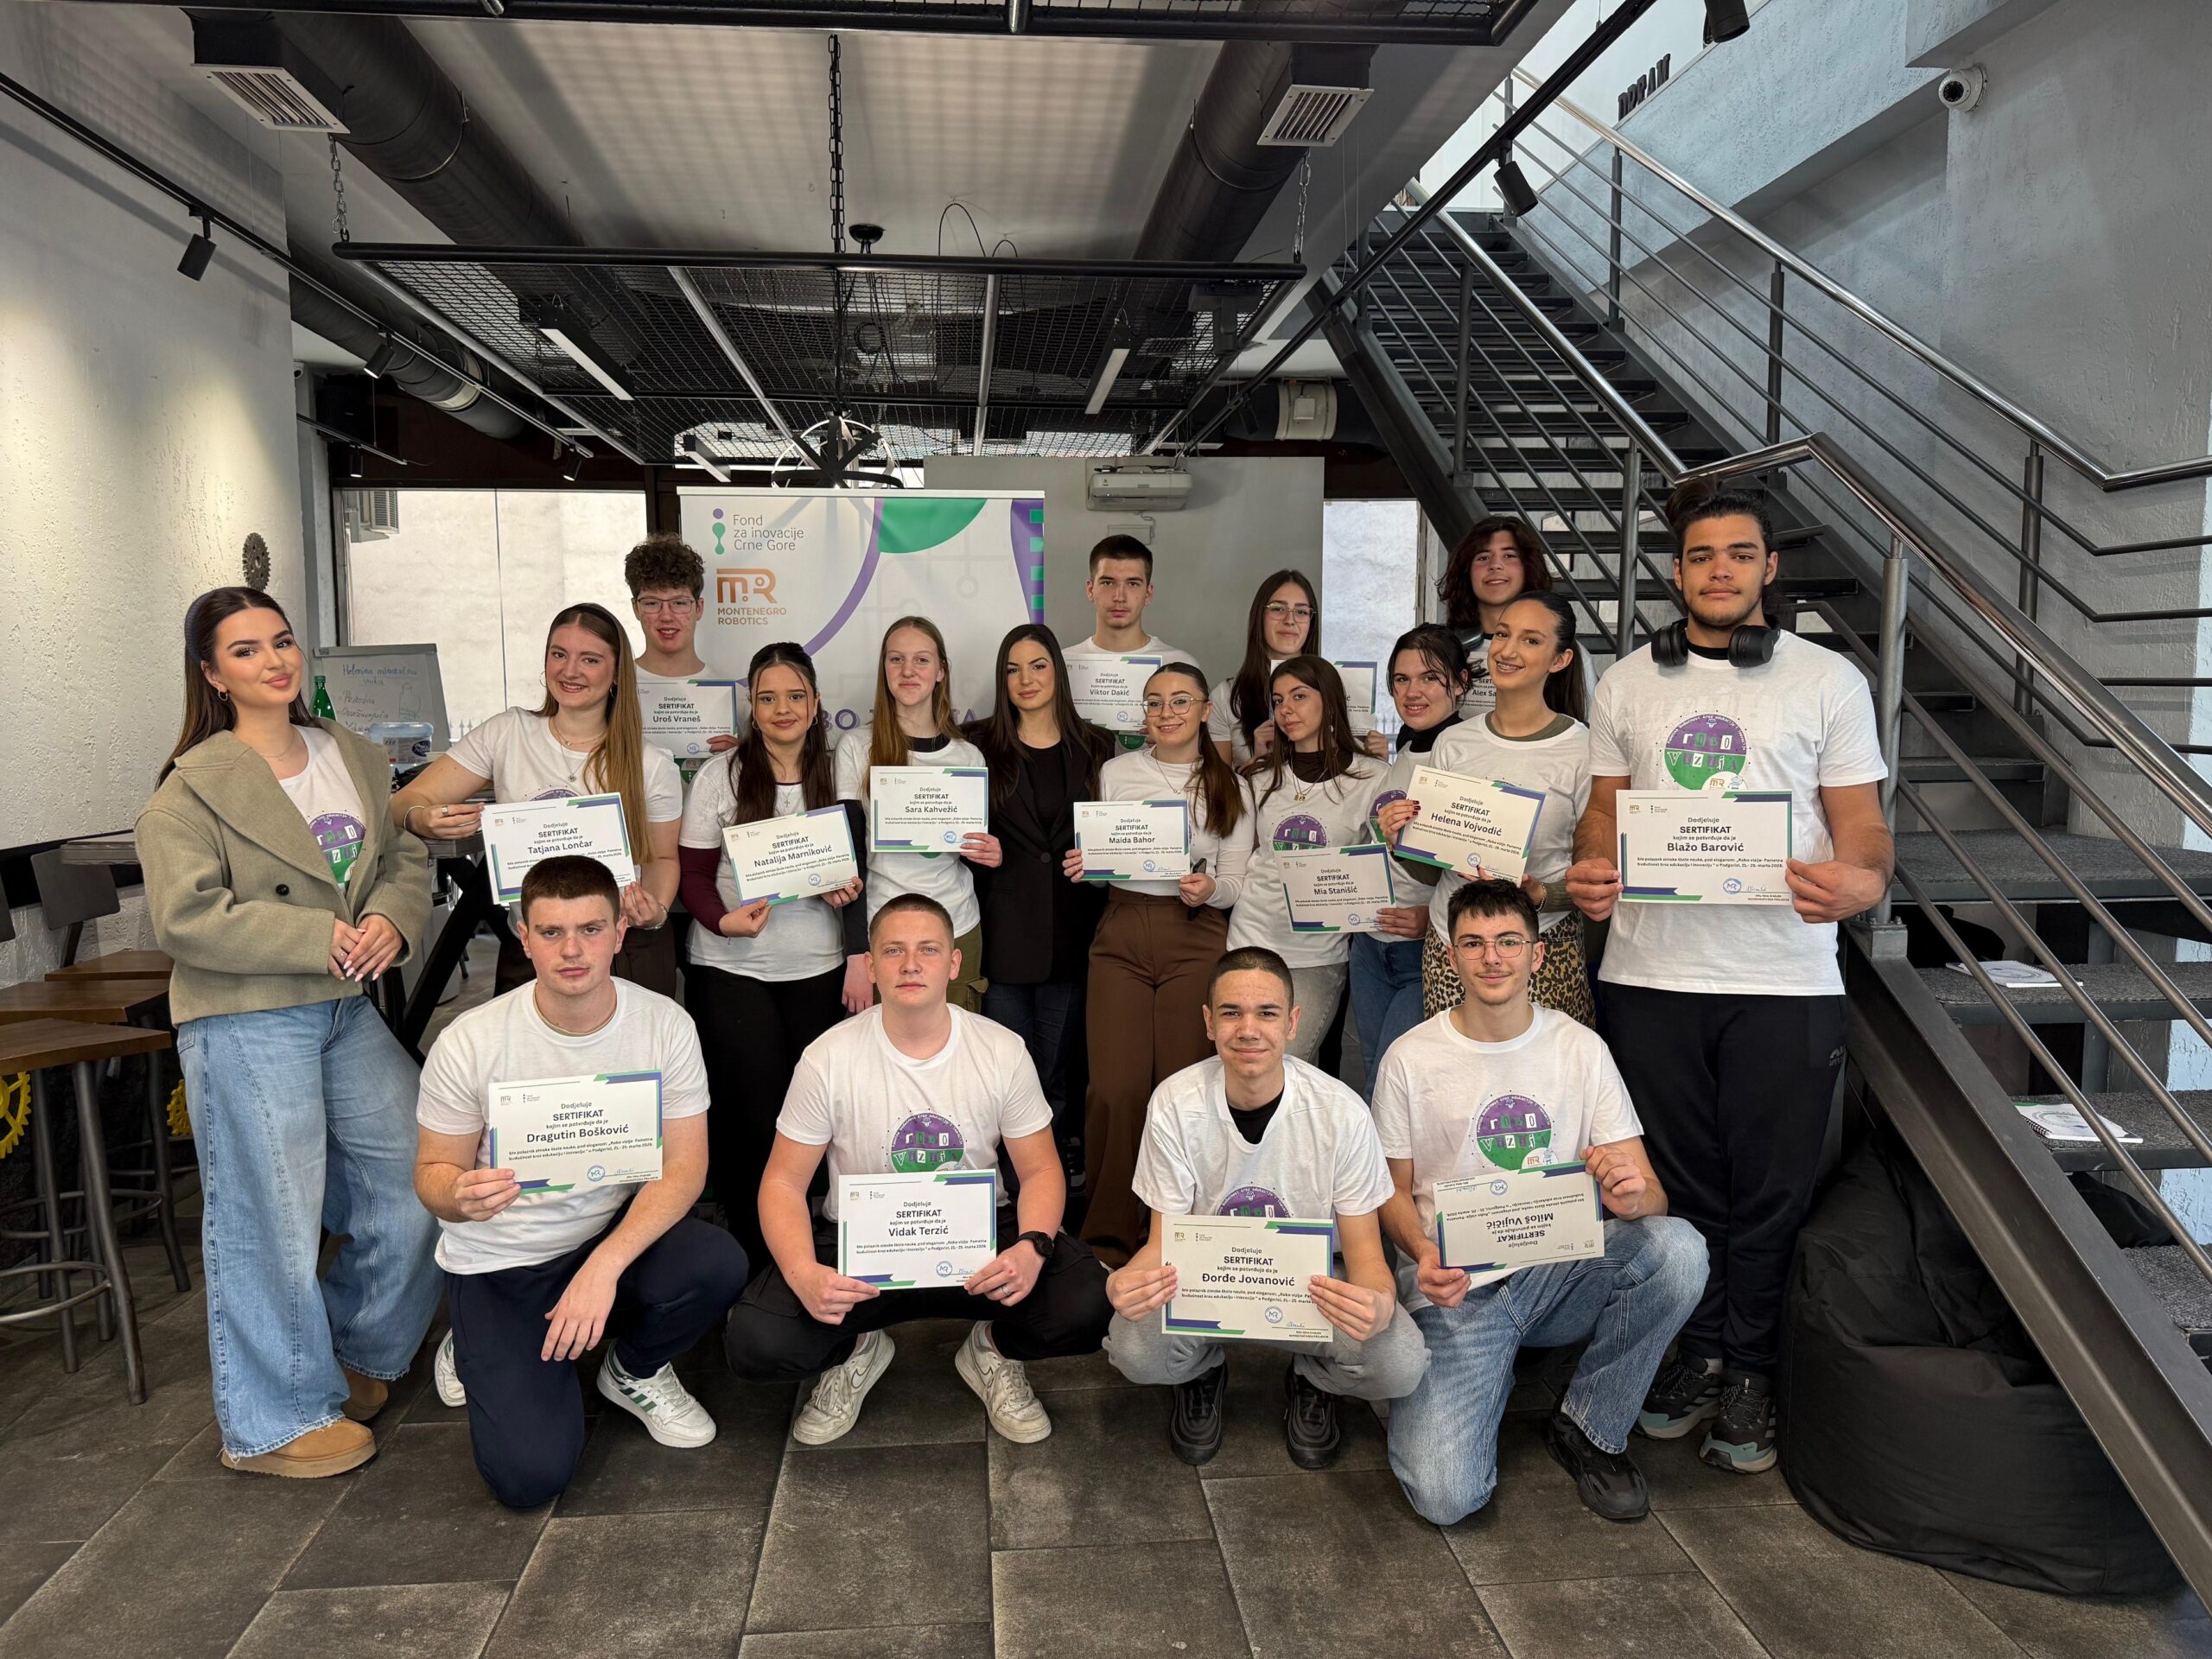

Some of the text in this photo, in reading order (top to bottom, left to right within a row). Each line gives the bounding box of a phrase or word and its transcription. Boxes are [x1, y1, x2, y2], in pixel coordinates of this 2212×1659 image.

[733, 514, 763, 526] Fond
[734, 527, 804, 541] za inovacije
[734, 539, 796, 550] Crne Gore
[1452, 803, 1490, 816] SERTIFIKAT
[1431, 813, 1502, 836] Helena Vojvodić
[538, 828, 578, 837] SERTIFIKAT
[528, 841, 593, 855] Tatjana Lončar
[772, 836, 808, 849] SERTIFIKAT
[1668, 842, 1744, 852] Blažo Barović
[754, 845, 832, 867] Natalija Marniković
[553, 1109, 603, 1121] SERTIFIKAT
[527, 1124, 628, 1143] Dragutin Bošković
[897, 1210, 942, 1218] SERTIFIKAT
[1487, 1213, 1553, 1230] Miloš Vujičić
[889, 1225, 949, 1236] Vidak Terzić
[1497, 1230, 1545, 1243] SERTIFIKAT
[1224, 1256, 1273, 1266] SERTIFIKAT
[1203, 1274, 1294, 1286] Đorđe Jovanović
